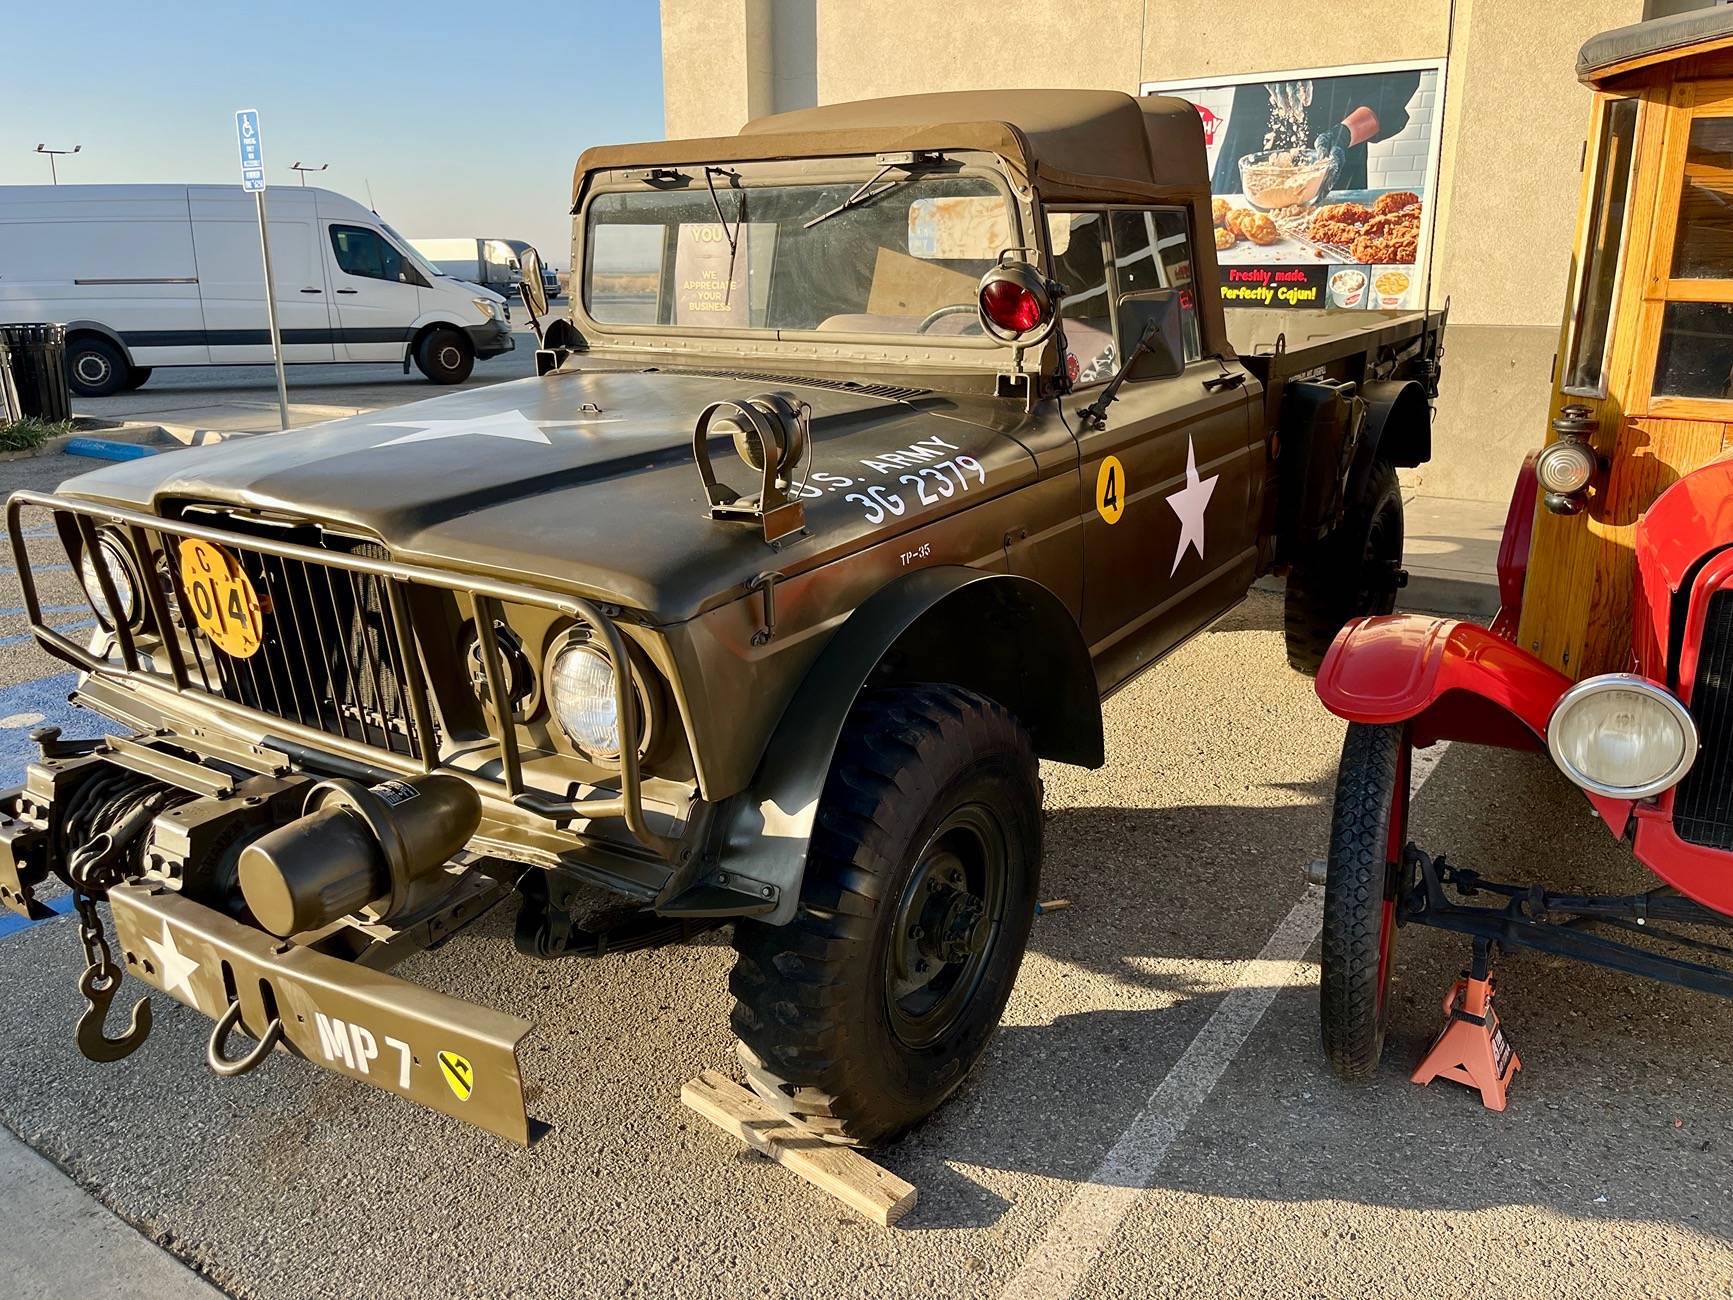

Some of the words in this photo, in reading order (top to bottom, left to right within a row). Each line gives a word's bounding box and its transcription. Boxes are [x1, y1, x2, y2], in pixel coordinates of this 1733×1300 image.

[691, 228, 723, 242] YOU
[702, 271, 717, 279] WE
[1229, 268, 1271, 286] Freshly
[1275, 269, 1307, 283] made,
[697, 291, 722, 300] YOUR
[1220, 286, 1274, 305] Perfectly
[1277, 287, 1317, 306] Cajun!
[688, 302, 732, 312] BUSINESS
[860, 435, 960, 474] ARMY
[845, 485, 905, 524] 3G
[899, 455, 985, 506] 2379
[1103, 465, 1118, 512] 4
[195, 546, 211, 573] C
[900, 542, 931, 566] TP-35
[314, 1011, 378, 1075] MP
[384, 1035, 411, 1090] 7
